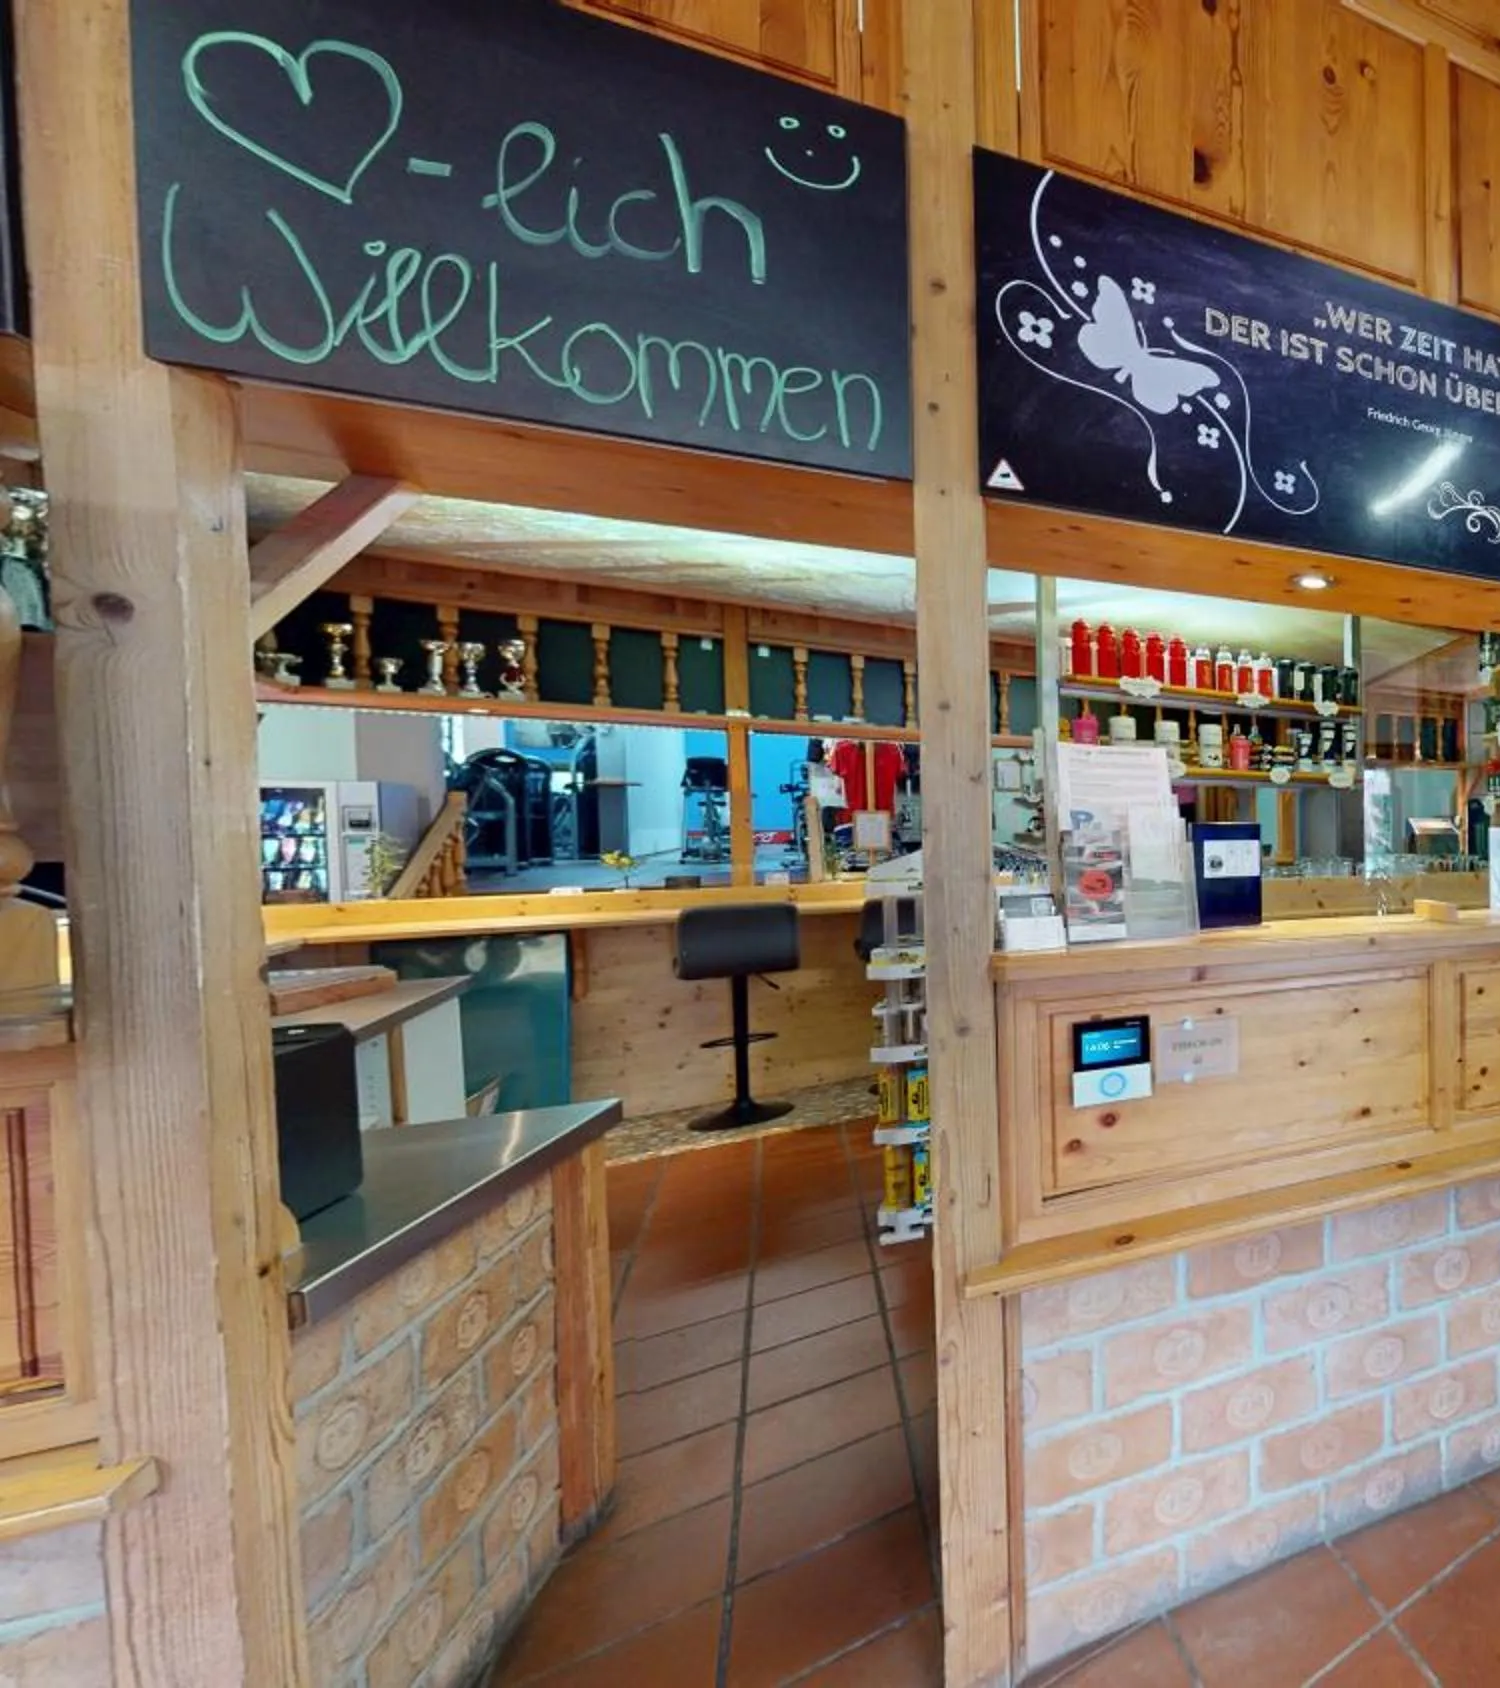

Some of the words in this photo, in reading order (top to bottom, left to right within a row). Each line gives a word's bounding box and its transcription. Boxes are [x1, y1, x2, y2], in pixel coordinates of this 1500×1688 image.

[162, 183, 884, 452] Willkommen
[1399, 325, 1457, 364] ZEIT
[1205, 307, 1271, 352] DER
[1280, 329, 1329, 366] IST
[1335, 346, 1438, 399] SCHON
[1367, 406, 1411, 428] Friedrich
